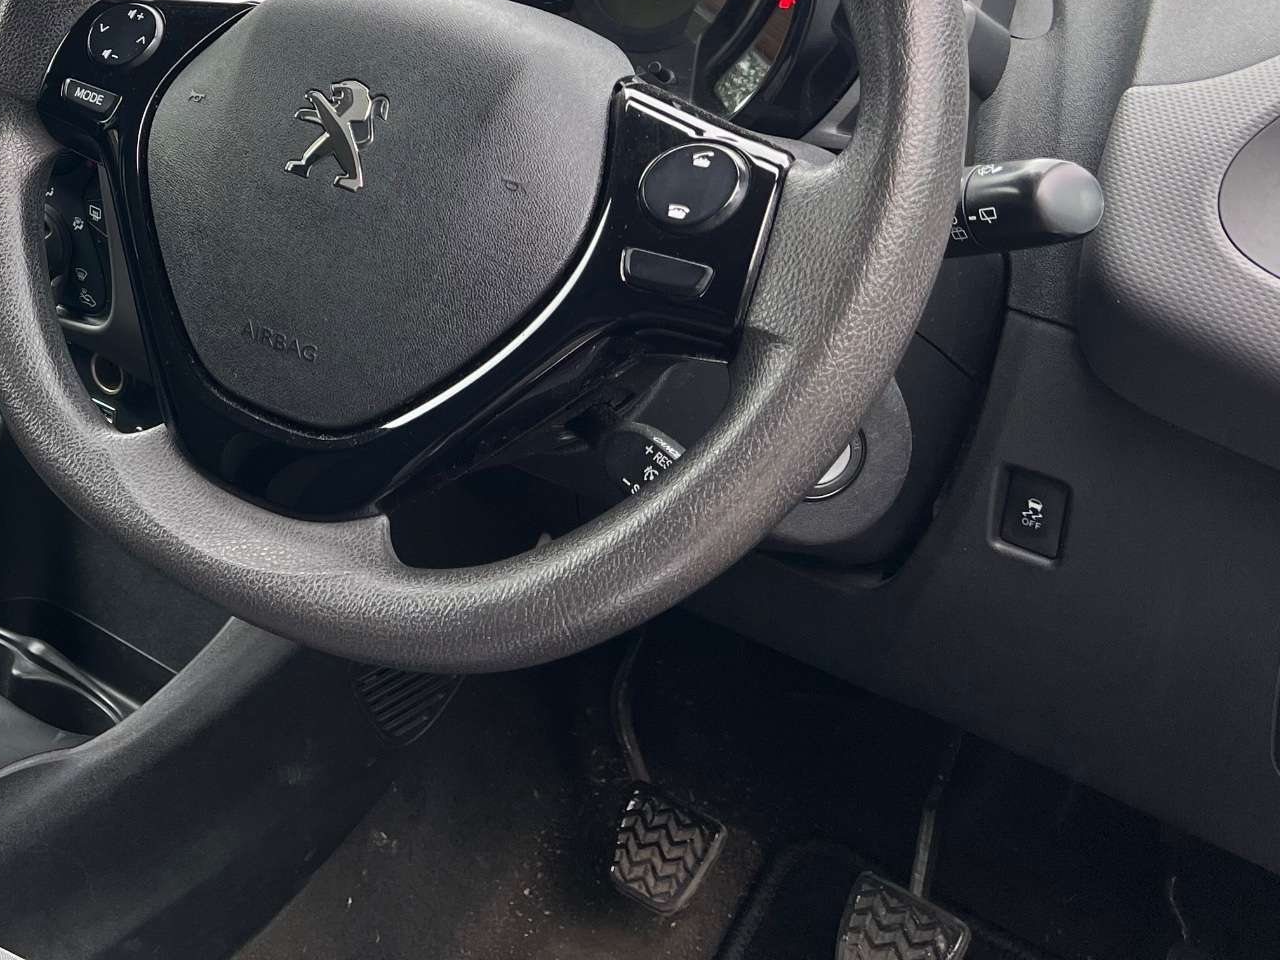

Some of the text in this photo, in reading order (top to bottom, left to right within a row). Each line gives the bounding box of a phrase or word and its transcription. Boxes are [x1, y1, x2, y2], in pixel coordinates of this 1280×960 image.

[74, 87, 105, 106] MODE
[242, 317, 318, 363] AIRBAG
[1021, 517, 1043, 530] OFF
